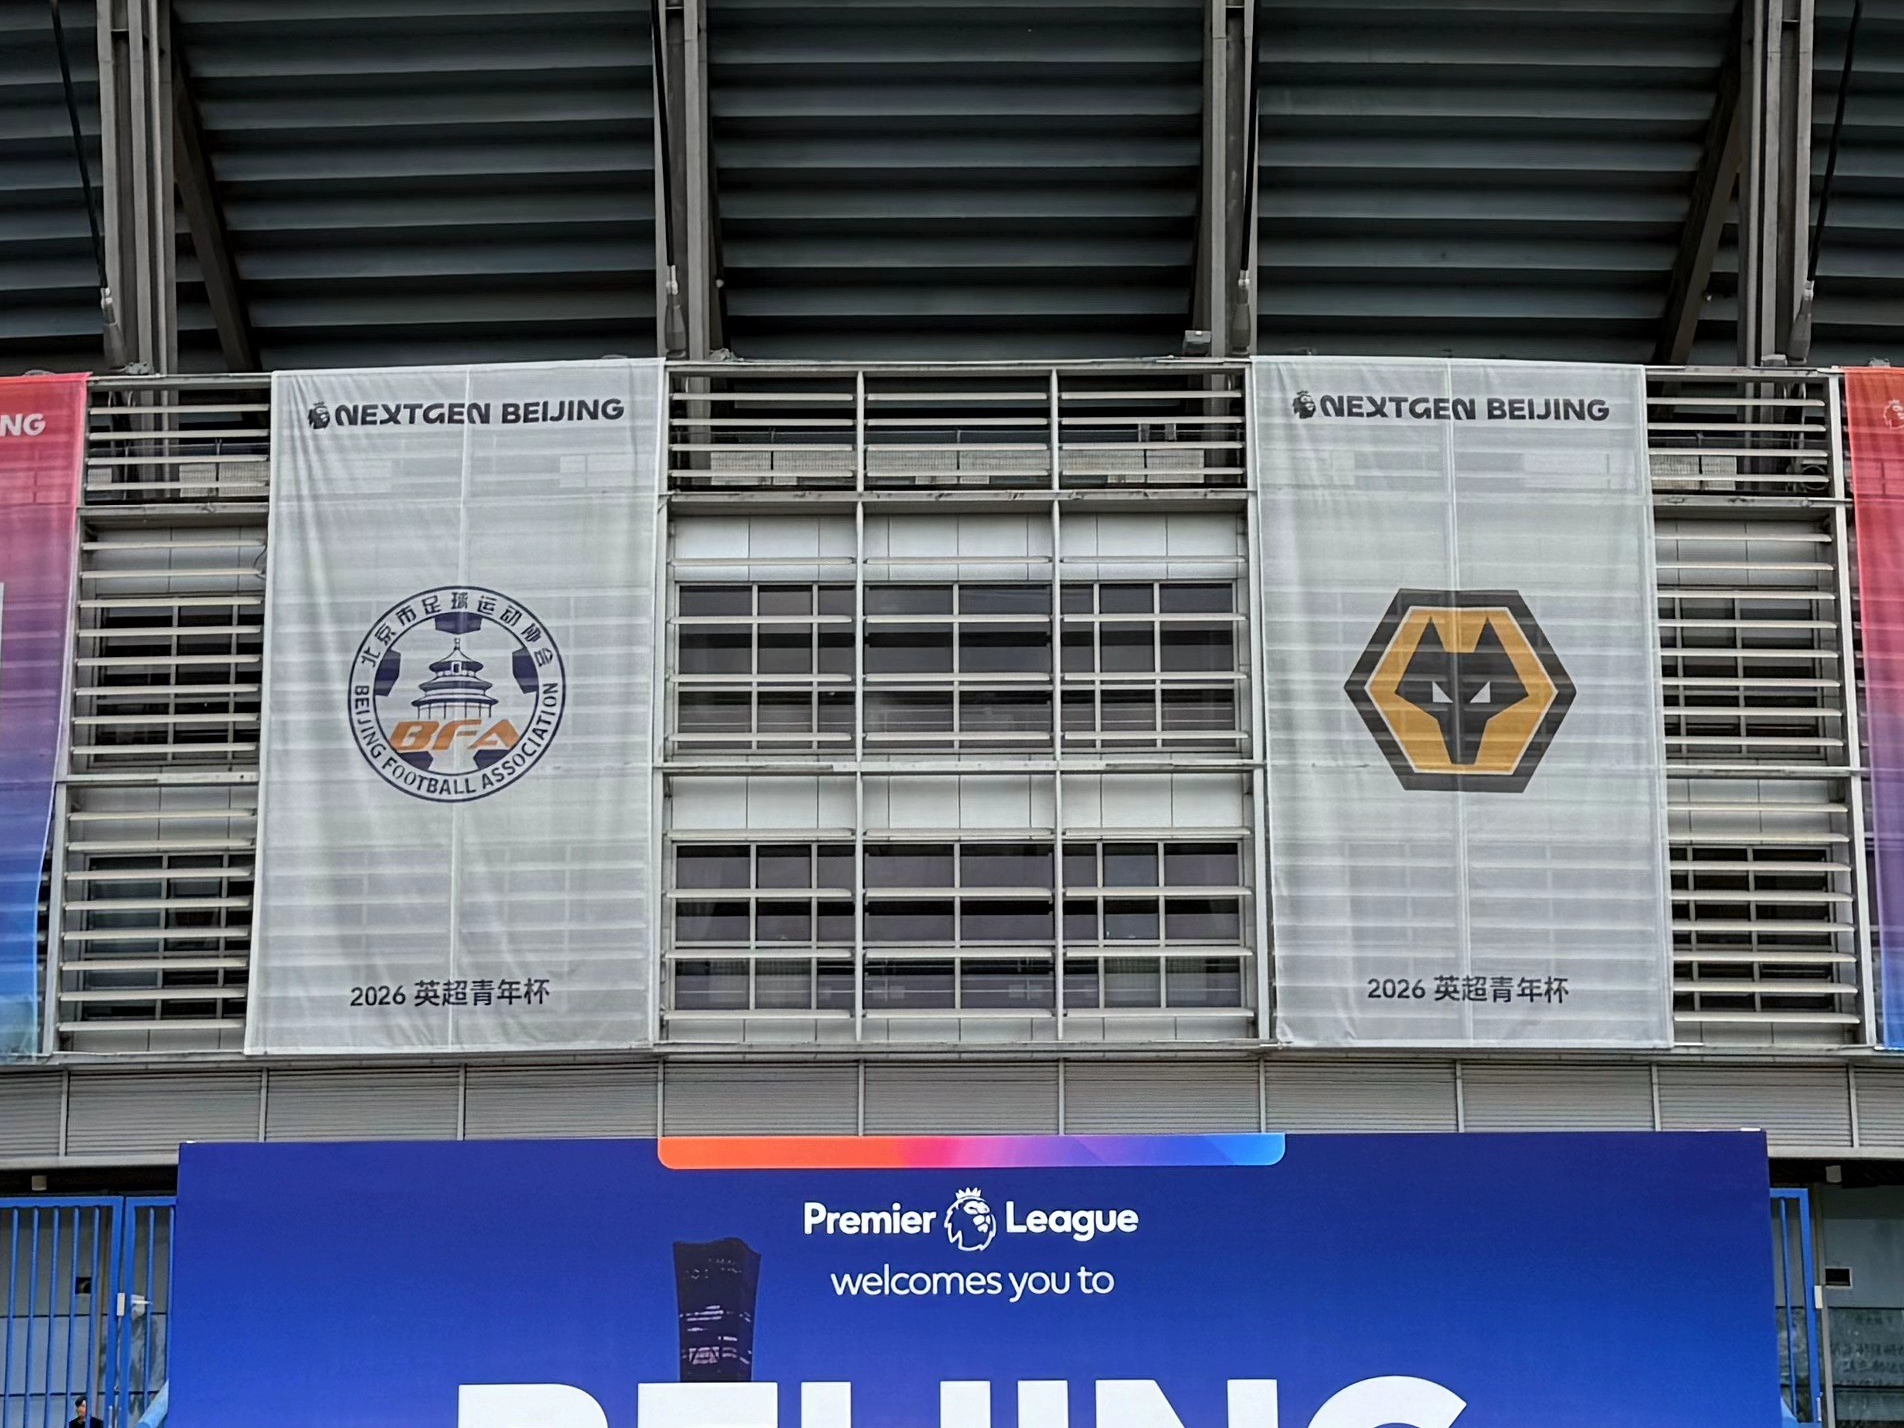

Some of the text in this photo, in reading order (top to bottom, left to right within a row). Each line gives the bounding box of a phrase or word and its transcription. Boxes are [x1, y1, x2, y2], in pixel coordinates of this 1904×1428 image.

[335, 398, 625, 426] NEXTGEN BEIJING
[1320, 395, 1610, 421] NEXTGEN BEIJING
[354, 682, 559, 796] BEIJING FOOTBALL ASSOCIATION
[389, 719, 521, 751] BFA
[350, 977, 550, 1007] 2026 英超青年杯
[1367, 974, 1569, 1004] 2026 英超青年杯
[804, 1201, 1139, 1241] Premier League
[830, 1263, 1115, 1303] welcomes you to
